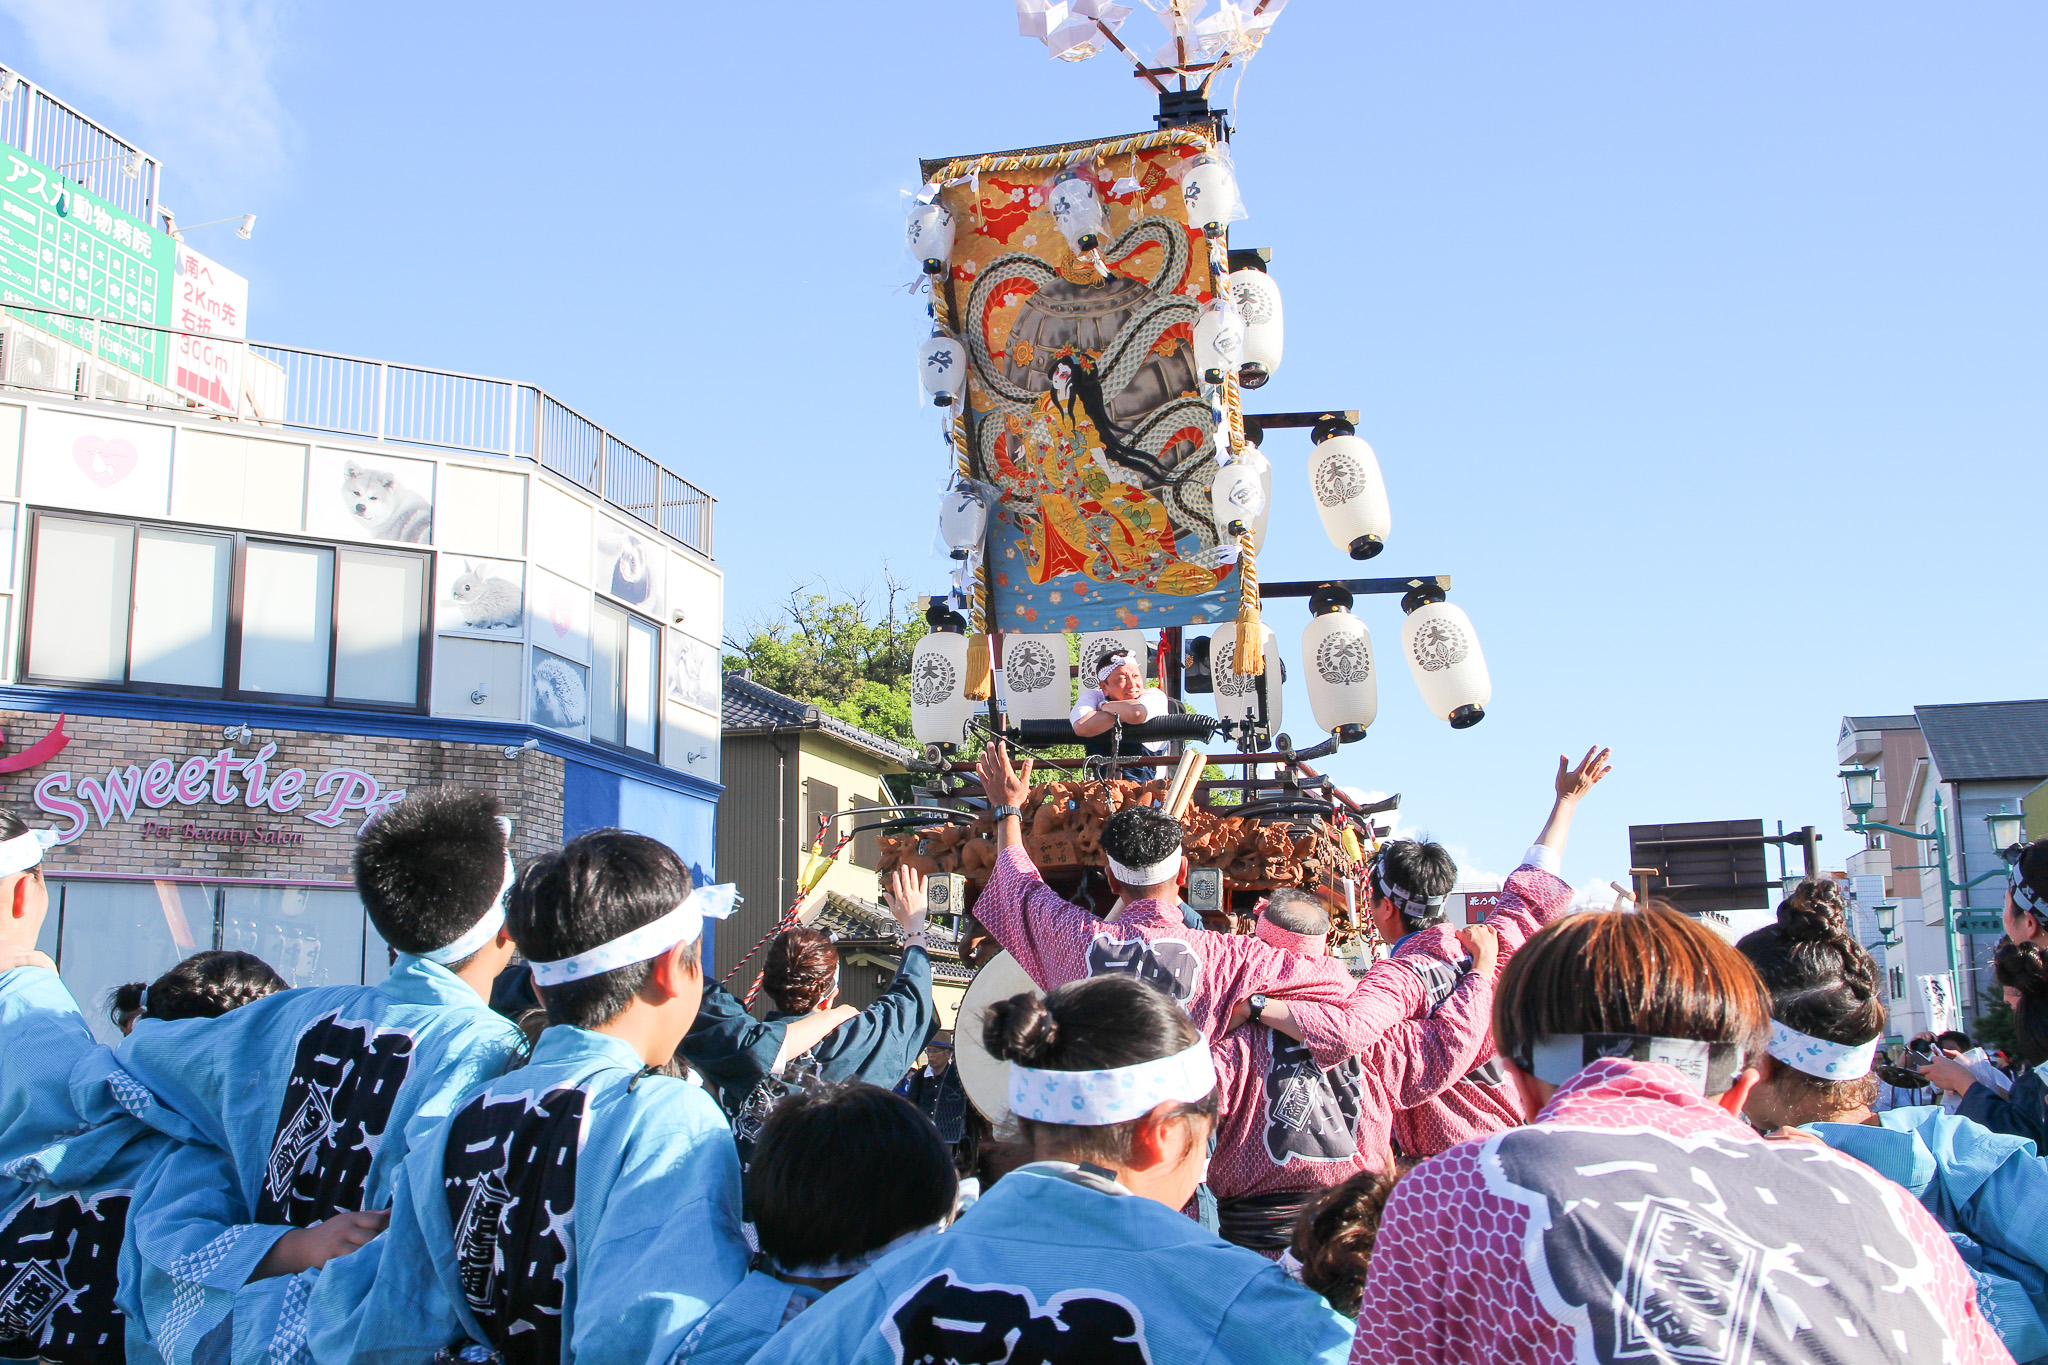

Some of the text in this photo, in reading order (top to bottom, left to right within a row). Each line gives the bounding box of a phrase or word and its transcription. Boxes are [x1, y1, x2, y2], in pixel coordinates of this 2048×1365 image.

[184, 254, 214, 286] 南へ
[920, 659, 939, 680] 大
[1018, 647, 1039, 667] 大
[33, 741, 307, 847] Sweetie
[141, 821, 306, 849] Pet Beauty Salon
